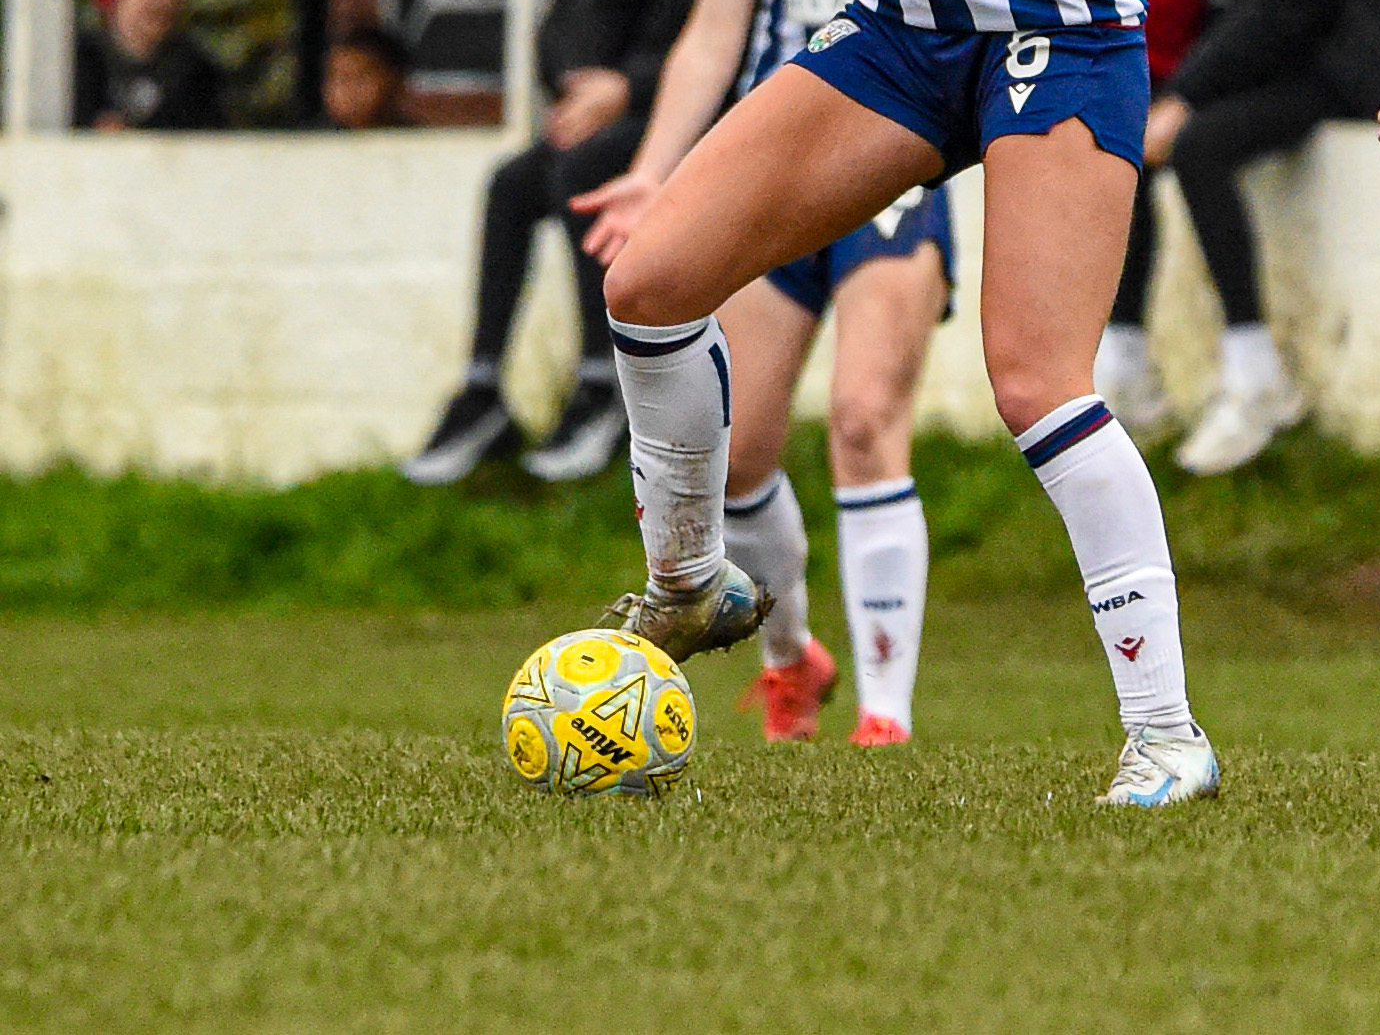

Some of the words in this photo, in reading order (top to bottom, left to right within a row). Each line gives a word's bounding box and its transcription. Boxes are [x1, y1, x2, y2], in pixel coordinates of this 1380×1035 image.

[1005, 30, 1051, 79] 6
[1091, 590, 1147, 614] WBA
[570, 717, 635, 765] Mitre
